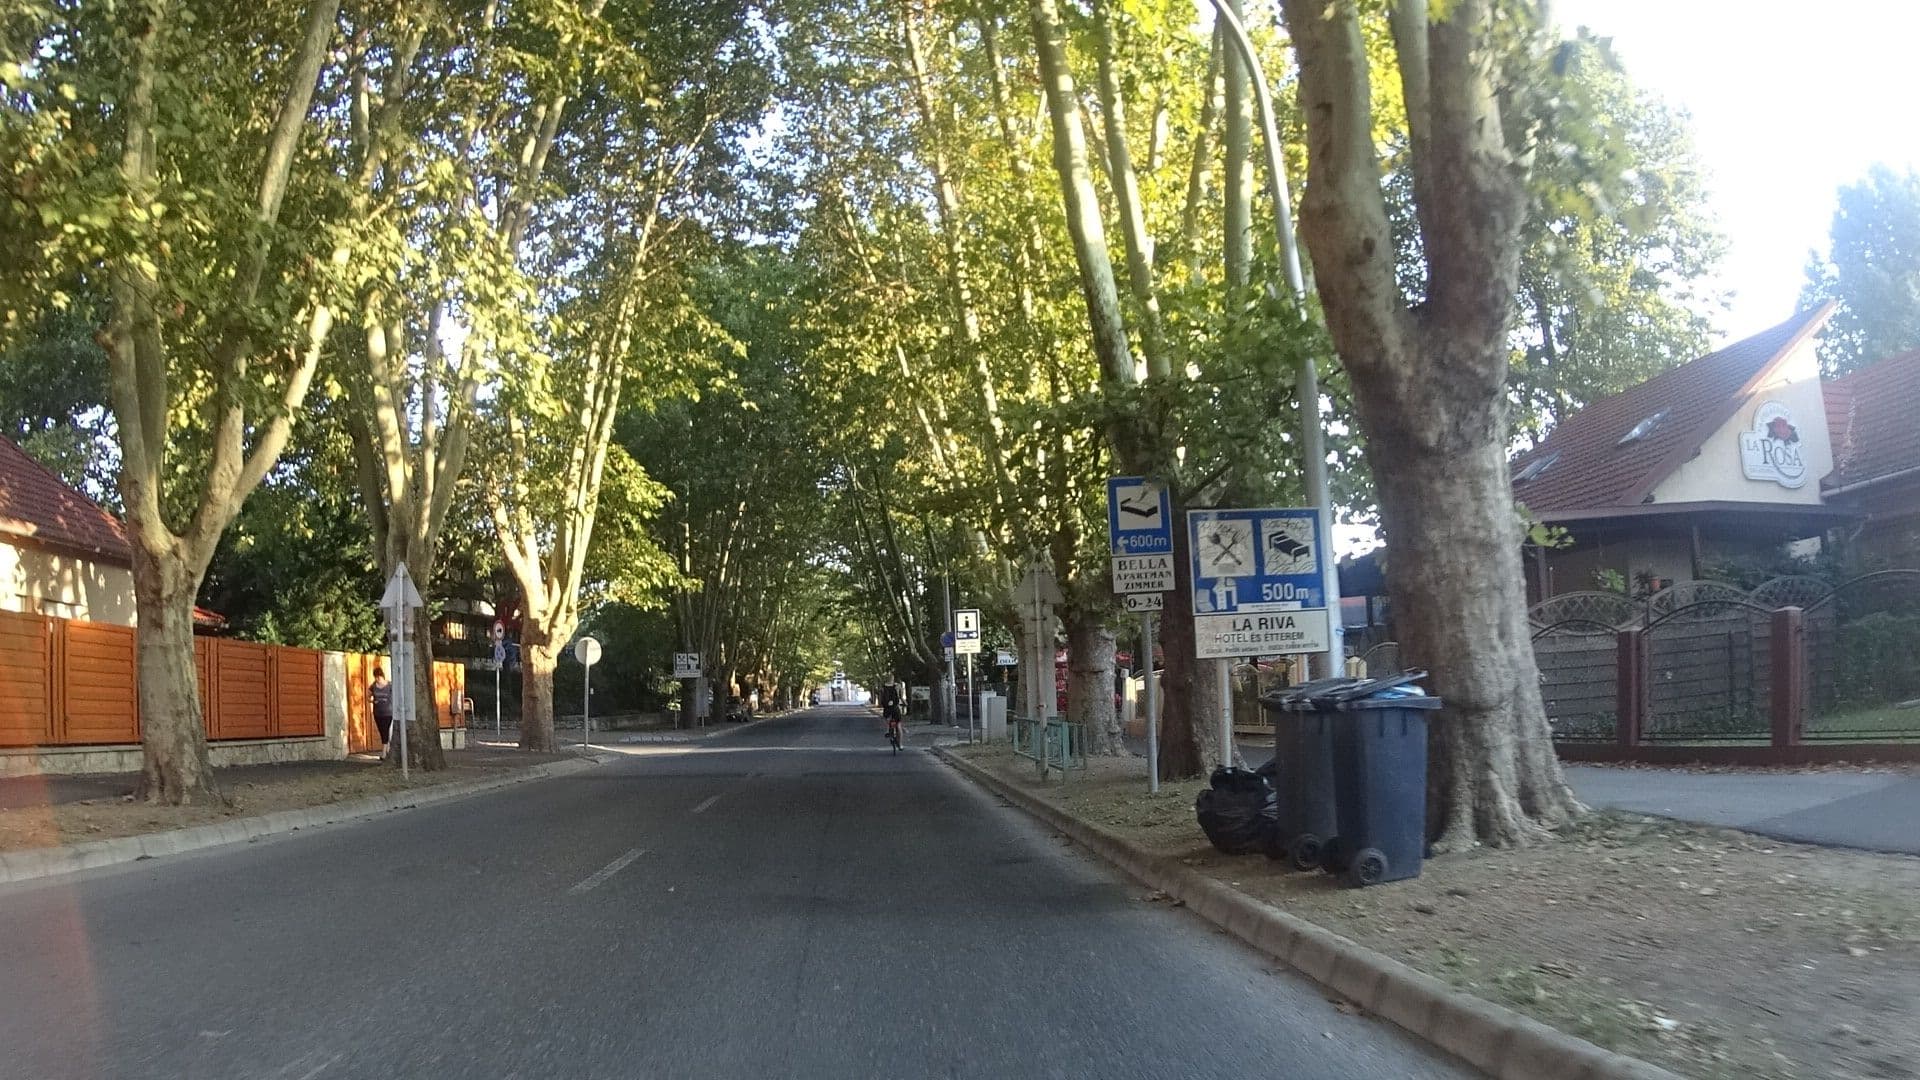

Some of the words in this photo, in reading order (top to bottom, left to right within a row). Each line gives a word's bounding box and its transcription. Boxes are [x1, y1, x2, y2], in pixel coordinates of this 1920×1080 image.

[1746, 439, 1760, 452] LA
[1118, 557, 1168, 571] BELLA
[1124, 580, 1165, 590] ZIMMER
[1232, 618, 1253, 632] LA
[1259, 615, 1296, 630] RIVA
[1214, 633, 1249, 643] HOTEL
